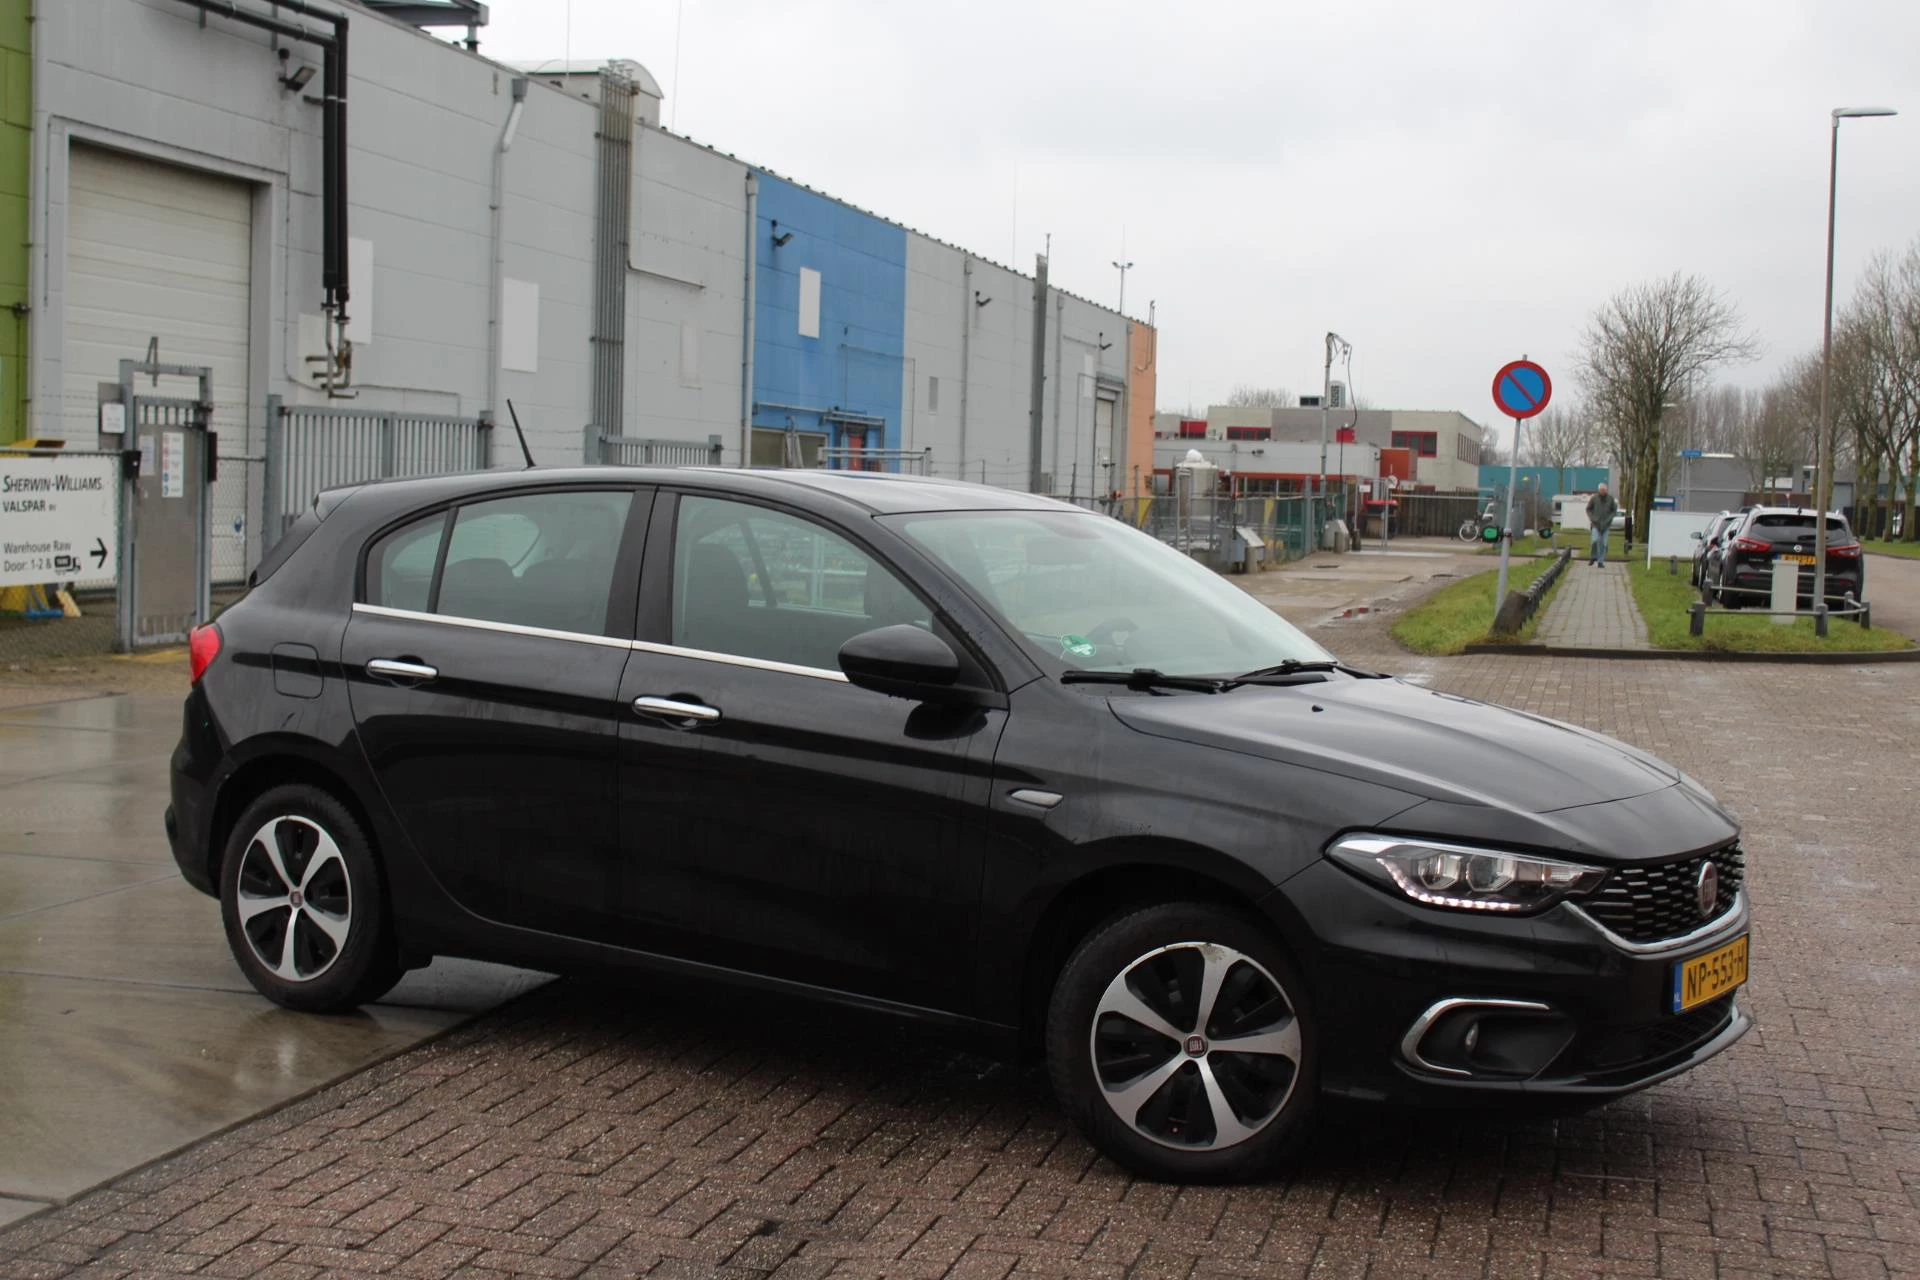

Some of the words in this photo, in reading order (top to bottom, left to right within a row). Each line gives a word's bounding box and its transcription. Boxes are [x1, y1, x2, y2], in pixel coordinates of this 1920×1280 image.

[3, 475, 102, 492] SHERWIN-WILLIAMS
[3, 500, 46, 512] VALSPAR
[4, 542, 51, 554] Warehouse
[53, 540, 71, 552] Raw
